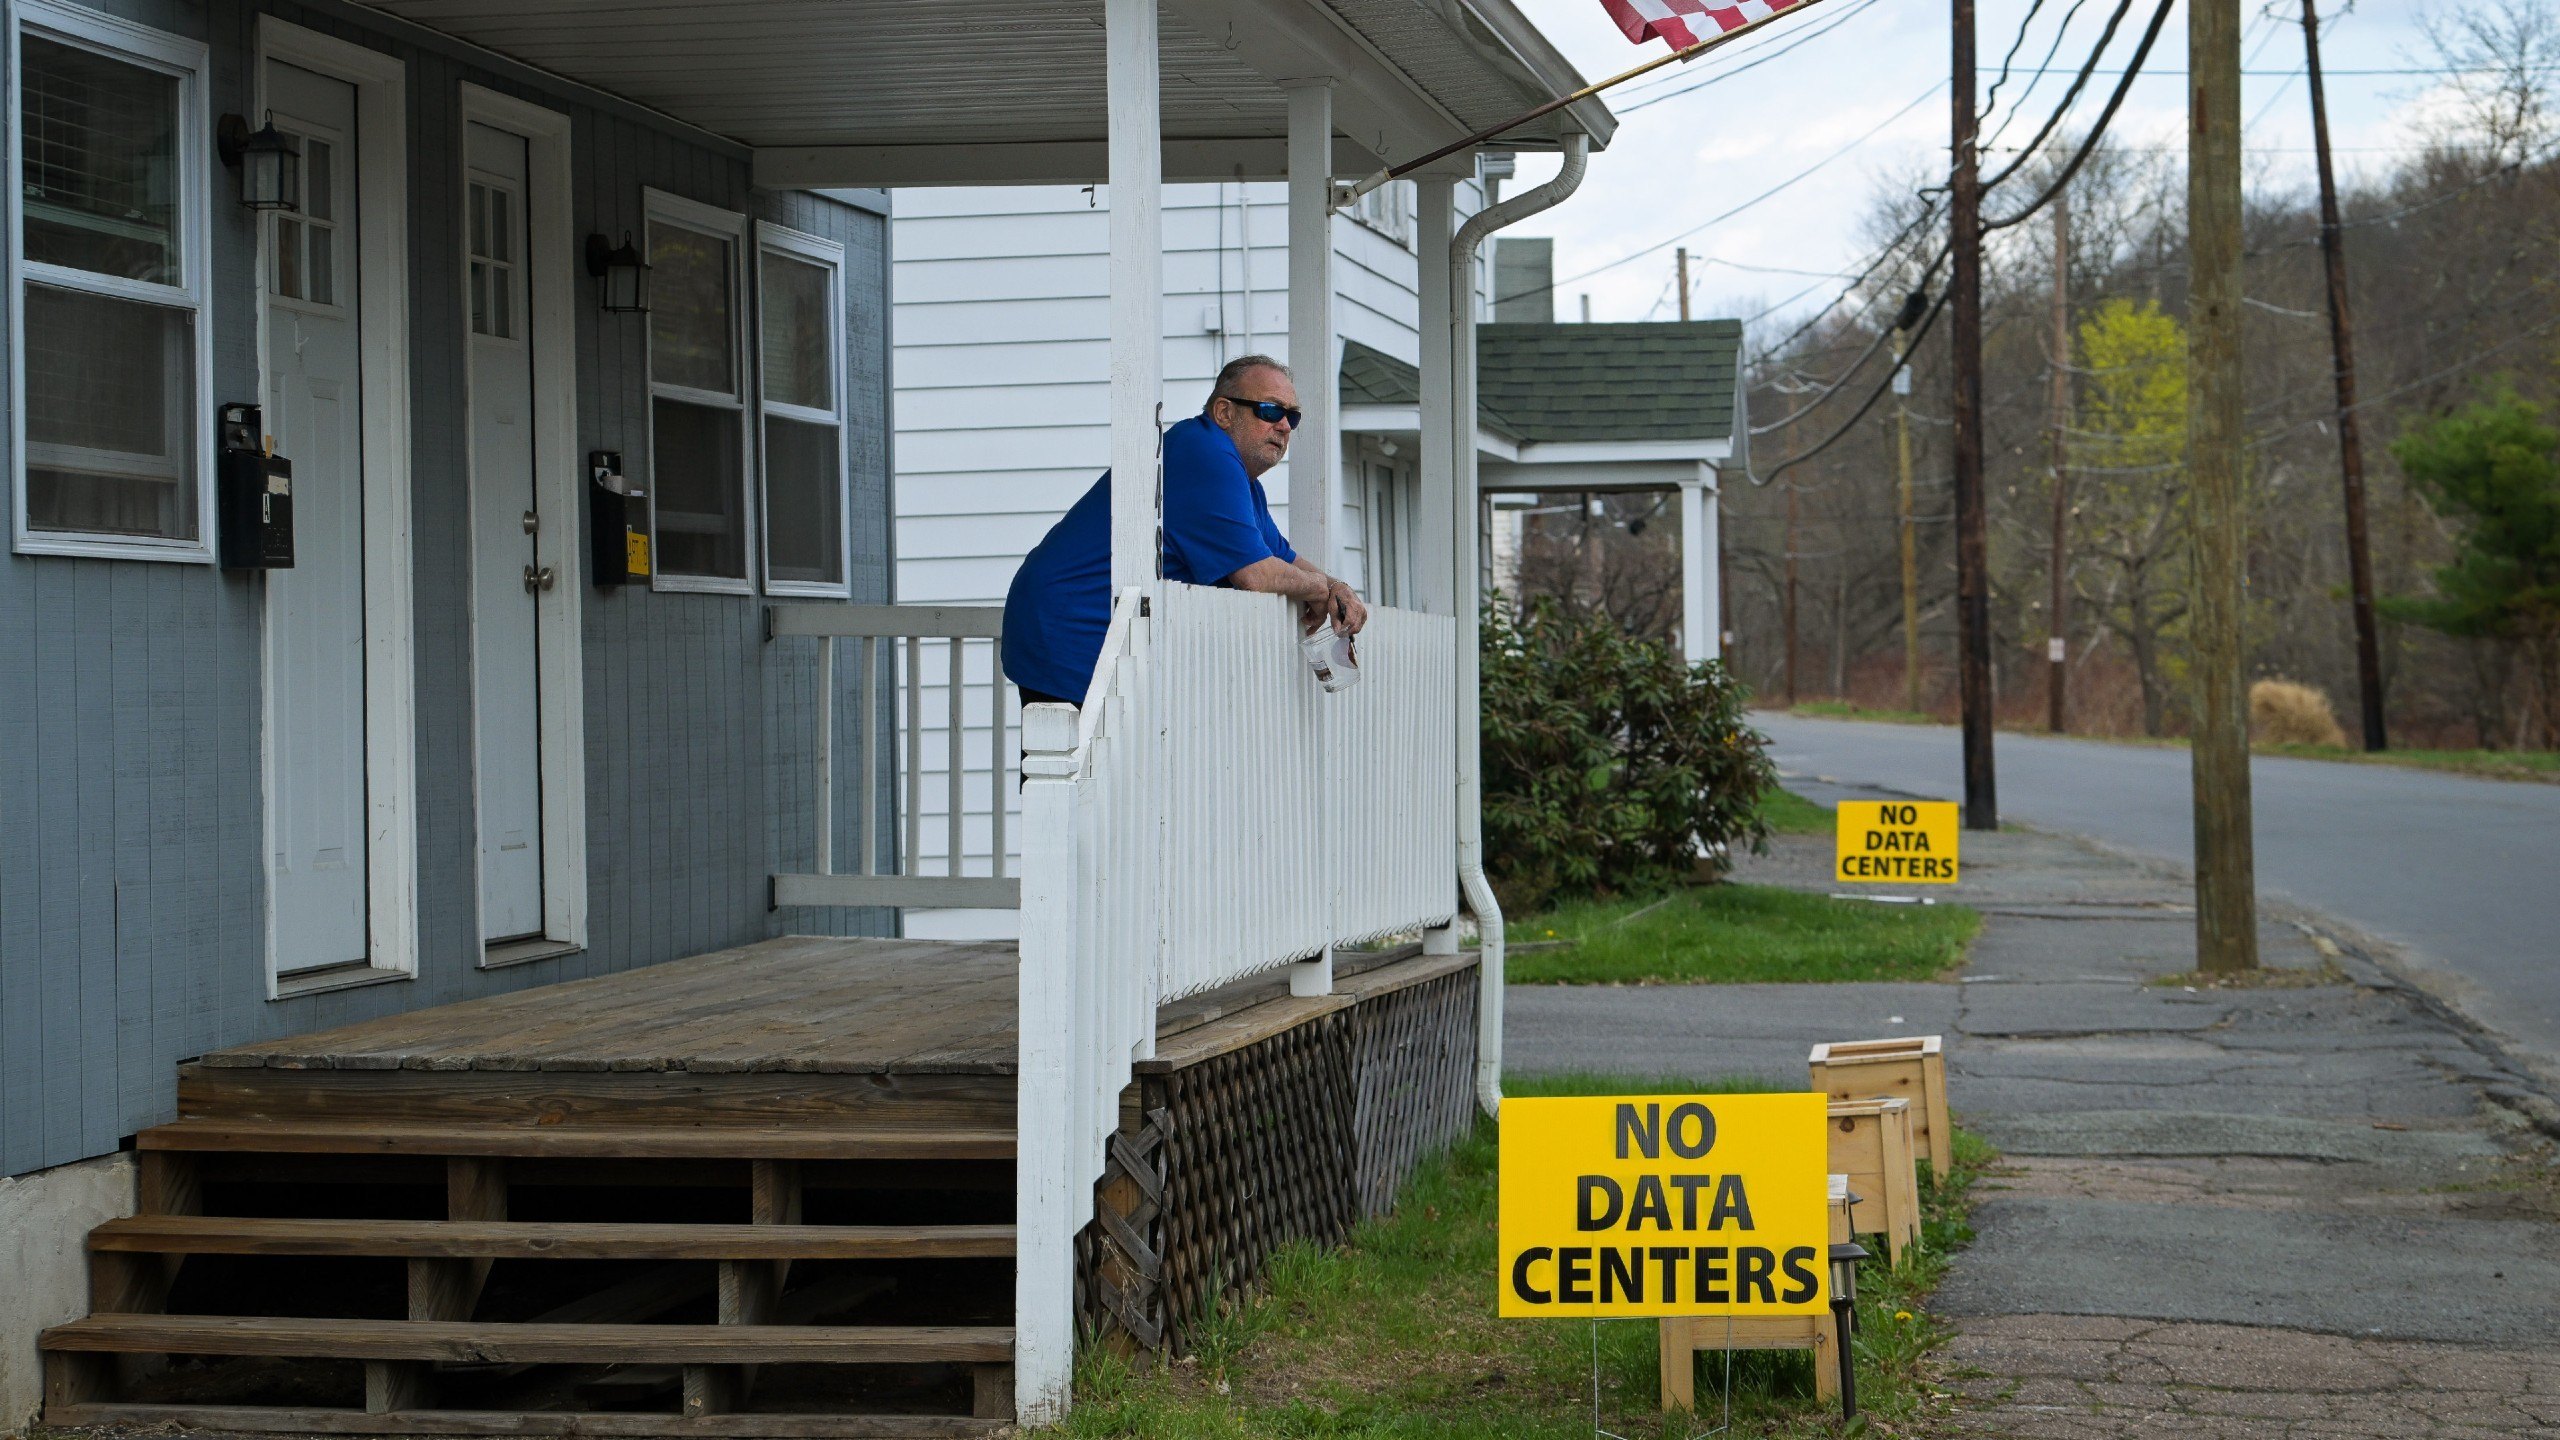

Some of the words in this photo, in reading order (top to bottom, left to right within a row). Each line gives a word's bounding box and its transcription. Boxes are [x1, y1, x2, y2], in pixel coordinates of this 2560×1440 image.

[1155, 401, 1163, 580] 548
[1866, 831, 1930, 851] DATA
[1880, 805, 1917, 825] NO
[1842, 856, 1953, 878] CENTERS
[1615, 1102, 1717, 1160] NO
[1576, 1174, 1755, 1232] DATA
[1511, 1246, 1820, 1305] CENTERS
